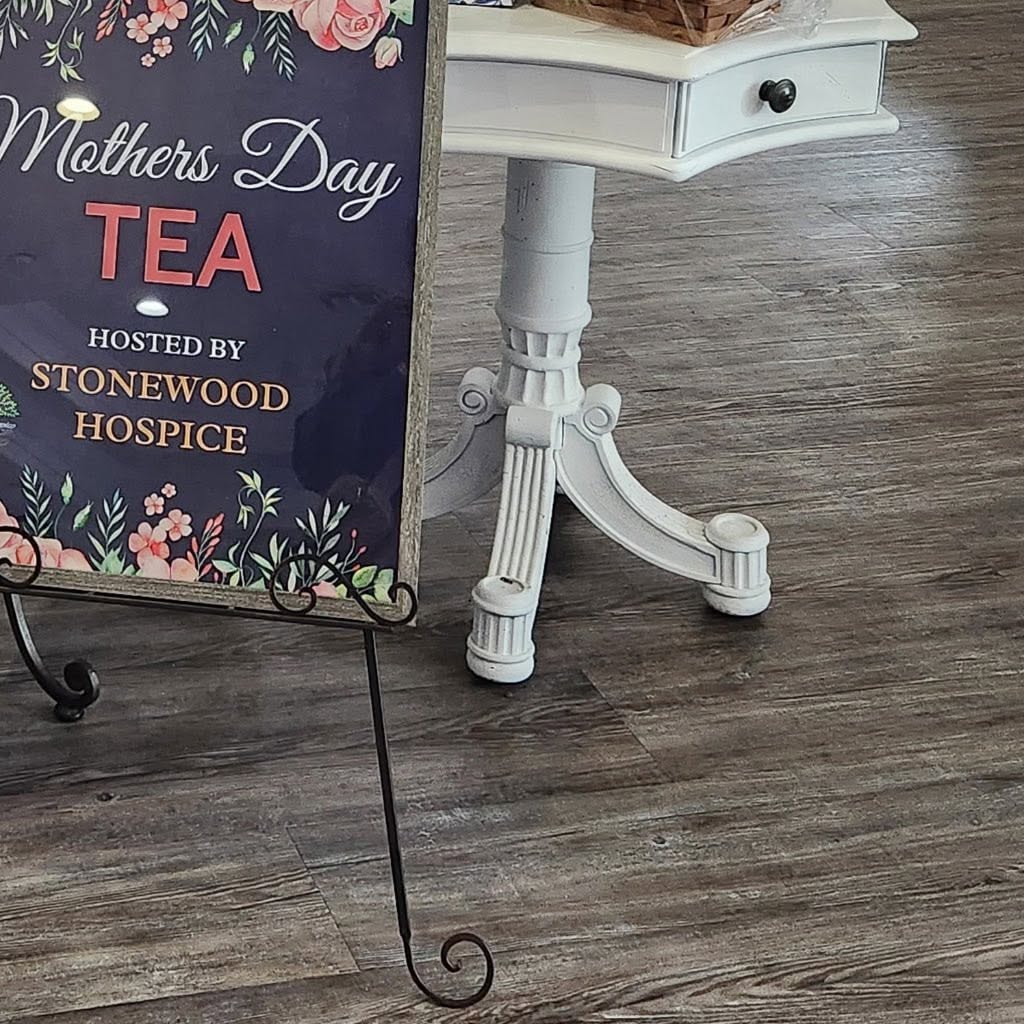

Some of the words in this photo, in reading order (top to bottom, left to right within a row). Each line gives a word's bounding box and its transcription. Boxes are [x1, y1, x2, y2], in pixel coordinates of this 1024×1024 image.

[232, 117, 402, 222] Day
[84, 201, 262, 293] TEA
[87, 327, 204, 358] HOSTED
[207, 336, 246, 361] BY
[30, 362, 291, 413] STONEWOOD
[72, 410, 249, 456] HOSPICE
